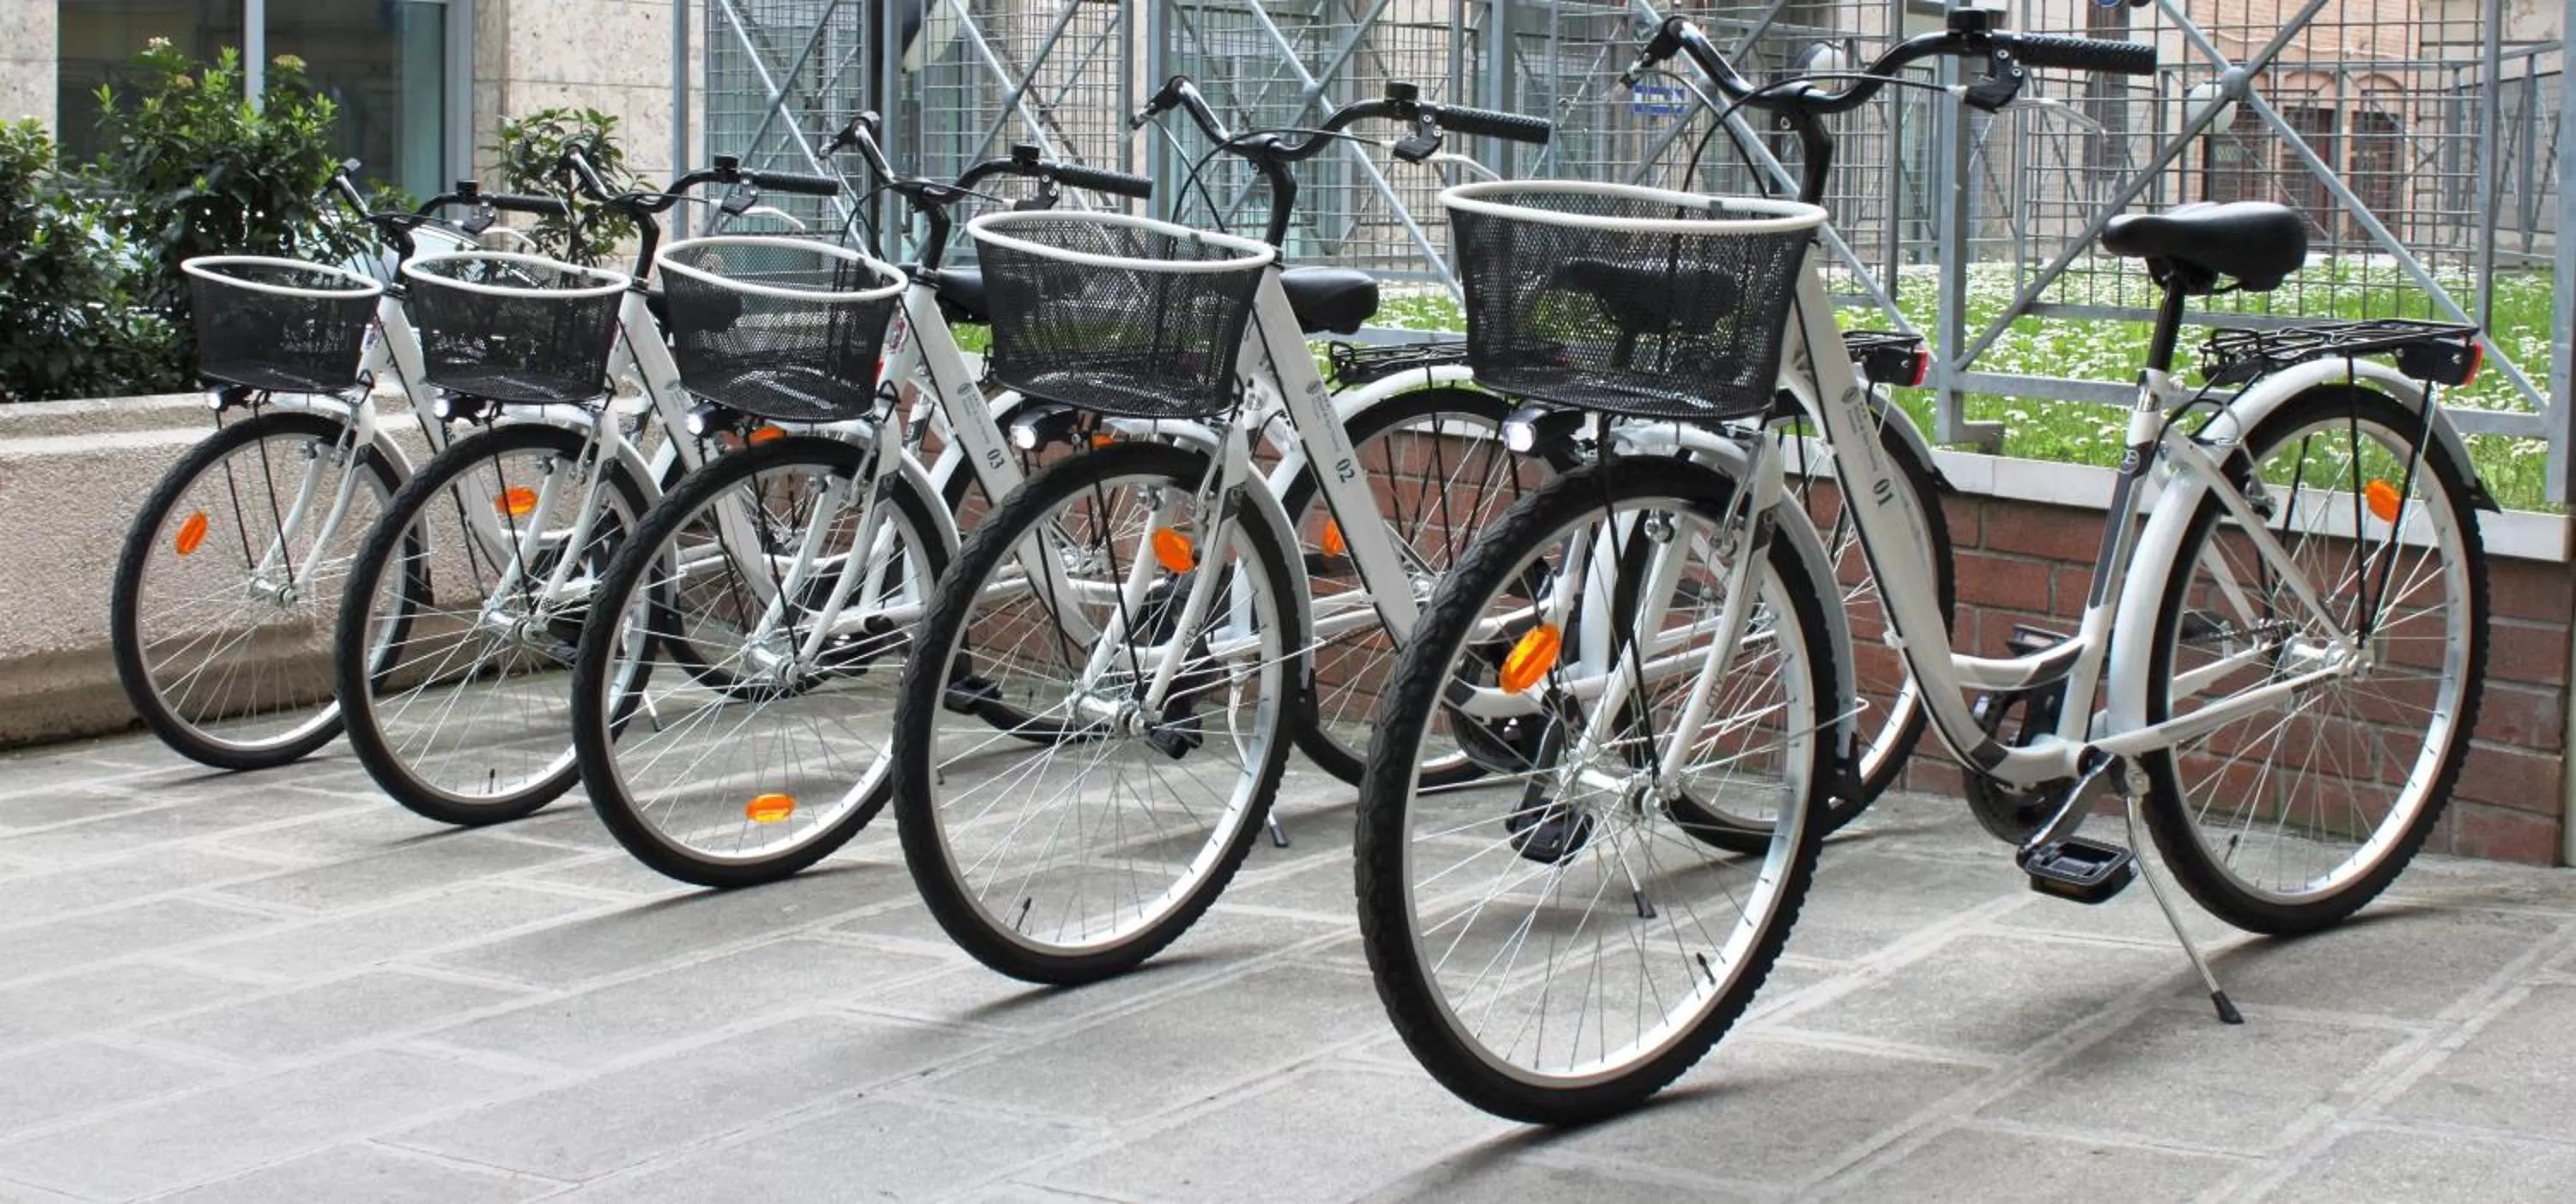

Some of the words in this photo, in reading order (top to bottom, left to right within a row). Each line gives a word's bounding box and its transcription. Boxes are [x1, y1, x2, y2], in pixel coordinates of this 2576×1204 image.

[987, 448, 1005, 470] 03
[1335, 458, 1355, 483] 02
[1874, 478, 1894, 508] 01
